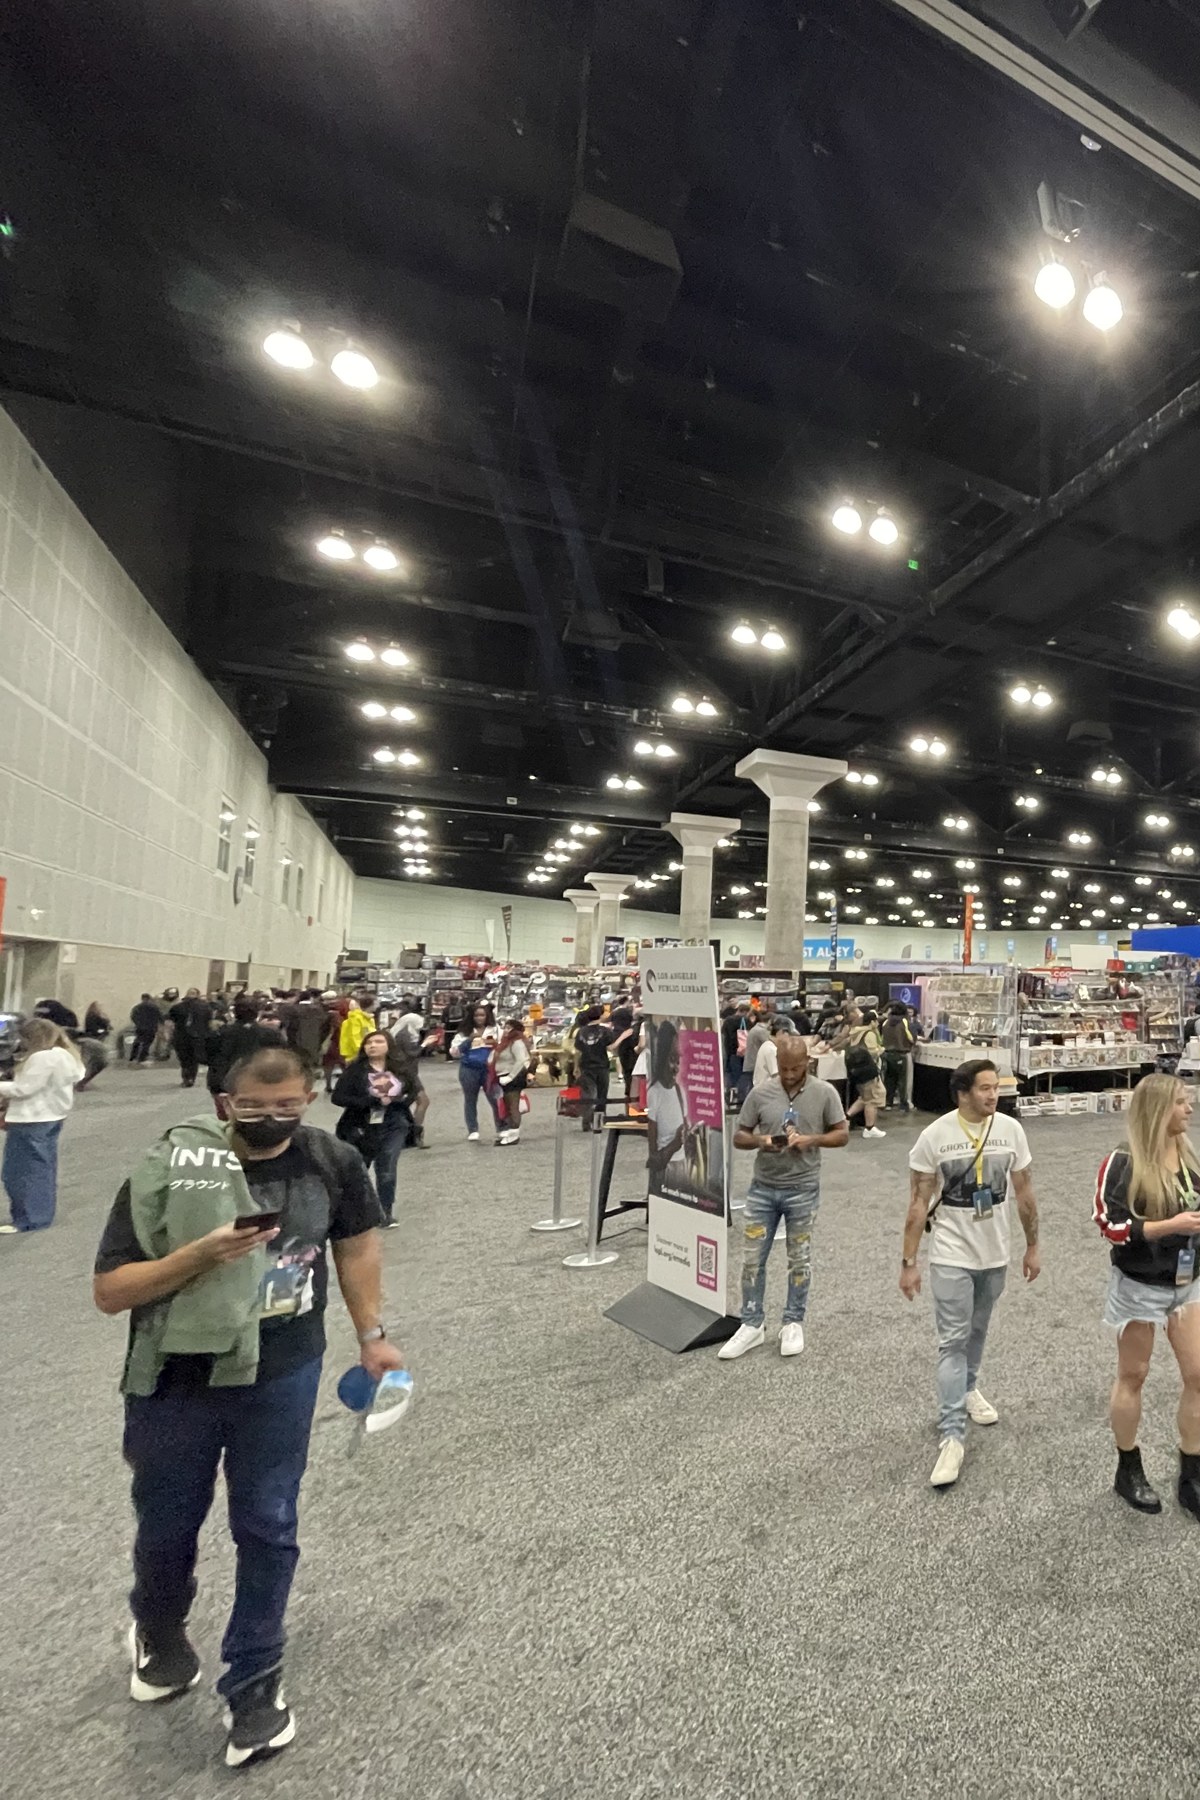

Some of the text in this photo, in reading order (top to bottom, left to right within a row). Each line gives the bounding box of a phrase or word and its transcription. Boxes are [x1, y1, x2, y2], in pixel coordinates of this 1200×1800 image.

[816, 946, 851, 958] ALEY
[657, 972, 697, 980] LOS ANGELES
[681, 985, 708, 993] LIBRARY
[940, 1142, 969, 1153] GHOST
